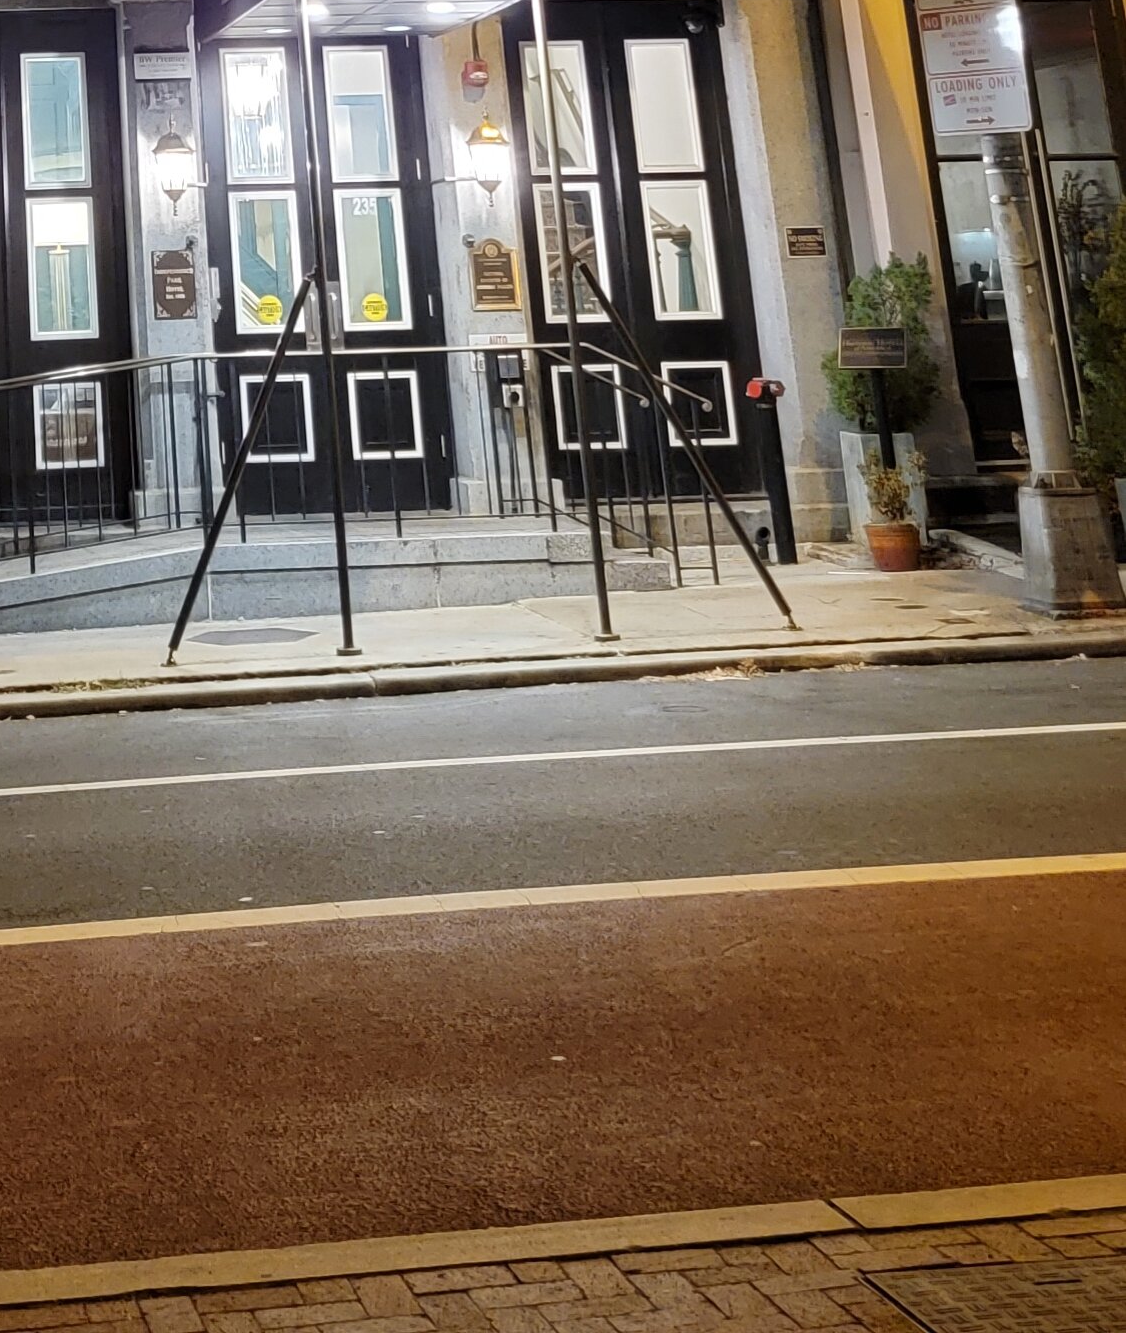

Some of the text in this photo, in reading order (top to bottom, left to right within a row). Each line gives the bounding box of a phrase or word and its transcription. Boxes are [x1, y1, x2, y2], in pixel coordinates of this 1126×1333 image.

[923, 13, 989, 29] NO PARKIN
[935, 75, 1017, 93] LOADING ONLY
[352, 197, 377, 216] 235
[489, 335, 508, 345] AUTO
